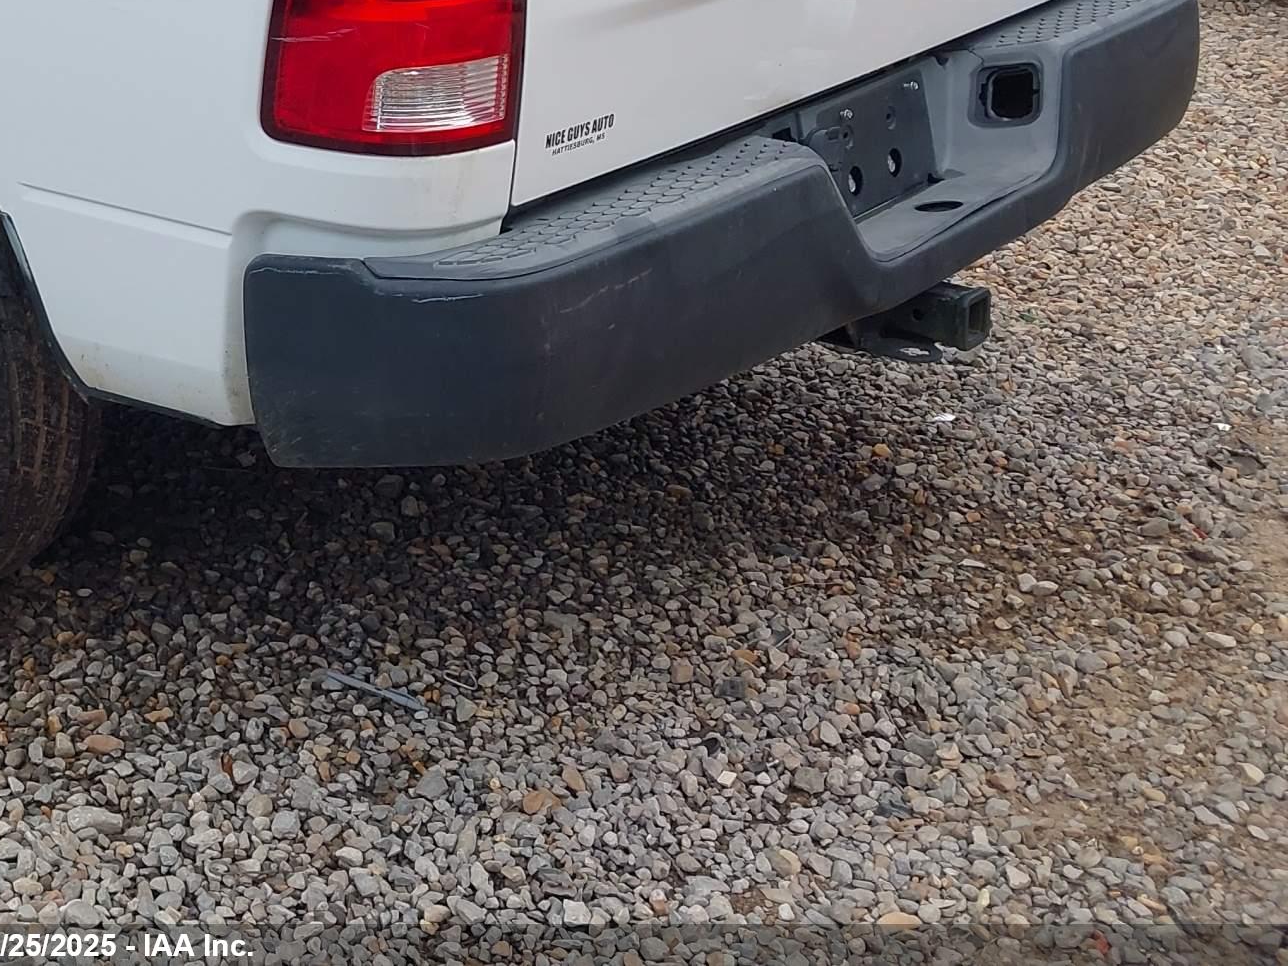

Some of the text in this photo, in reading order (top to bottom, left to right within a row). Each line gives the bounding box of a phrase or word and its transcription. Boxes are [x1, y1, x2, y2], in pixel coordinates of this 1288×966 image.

[545, 114, 615, 149] NICE GUYS AUTO
